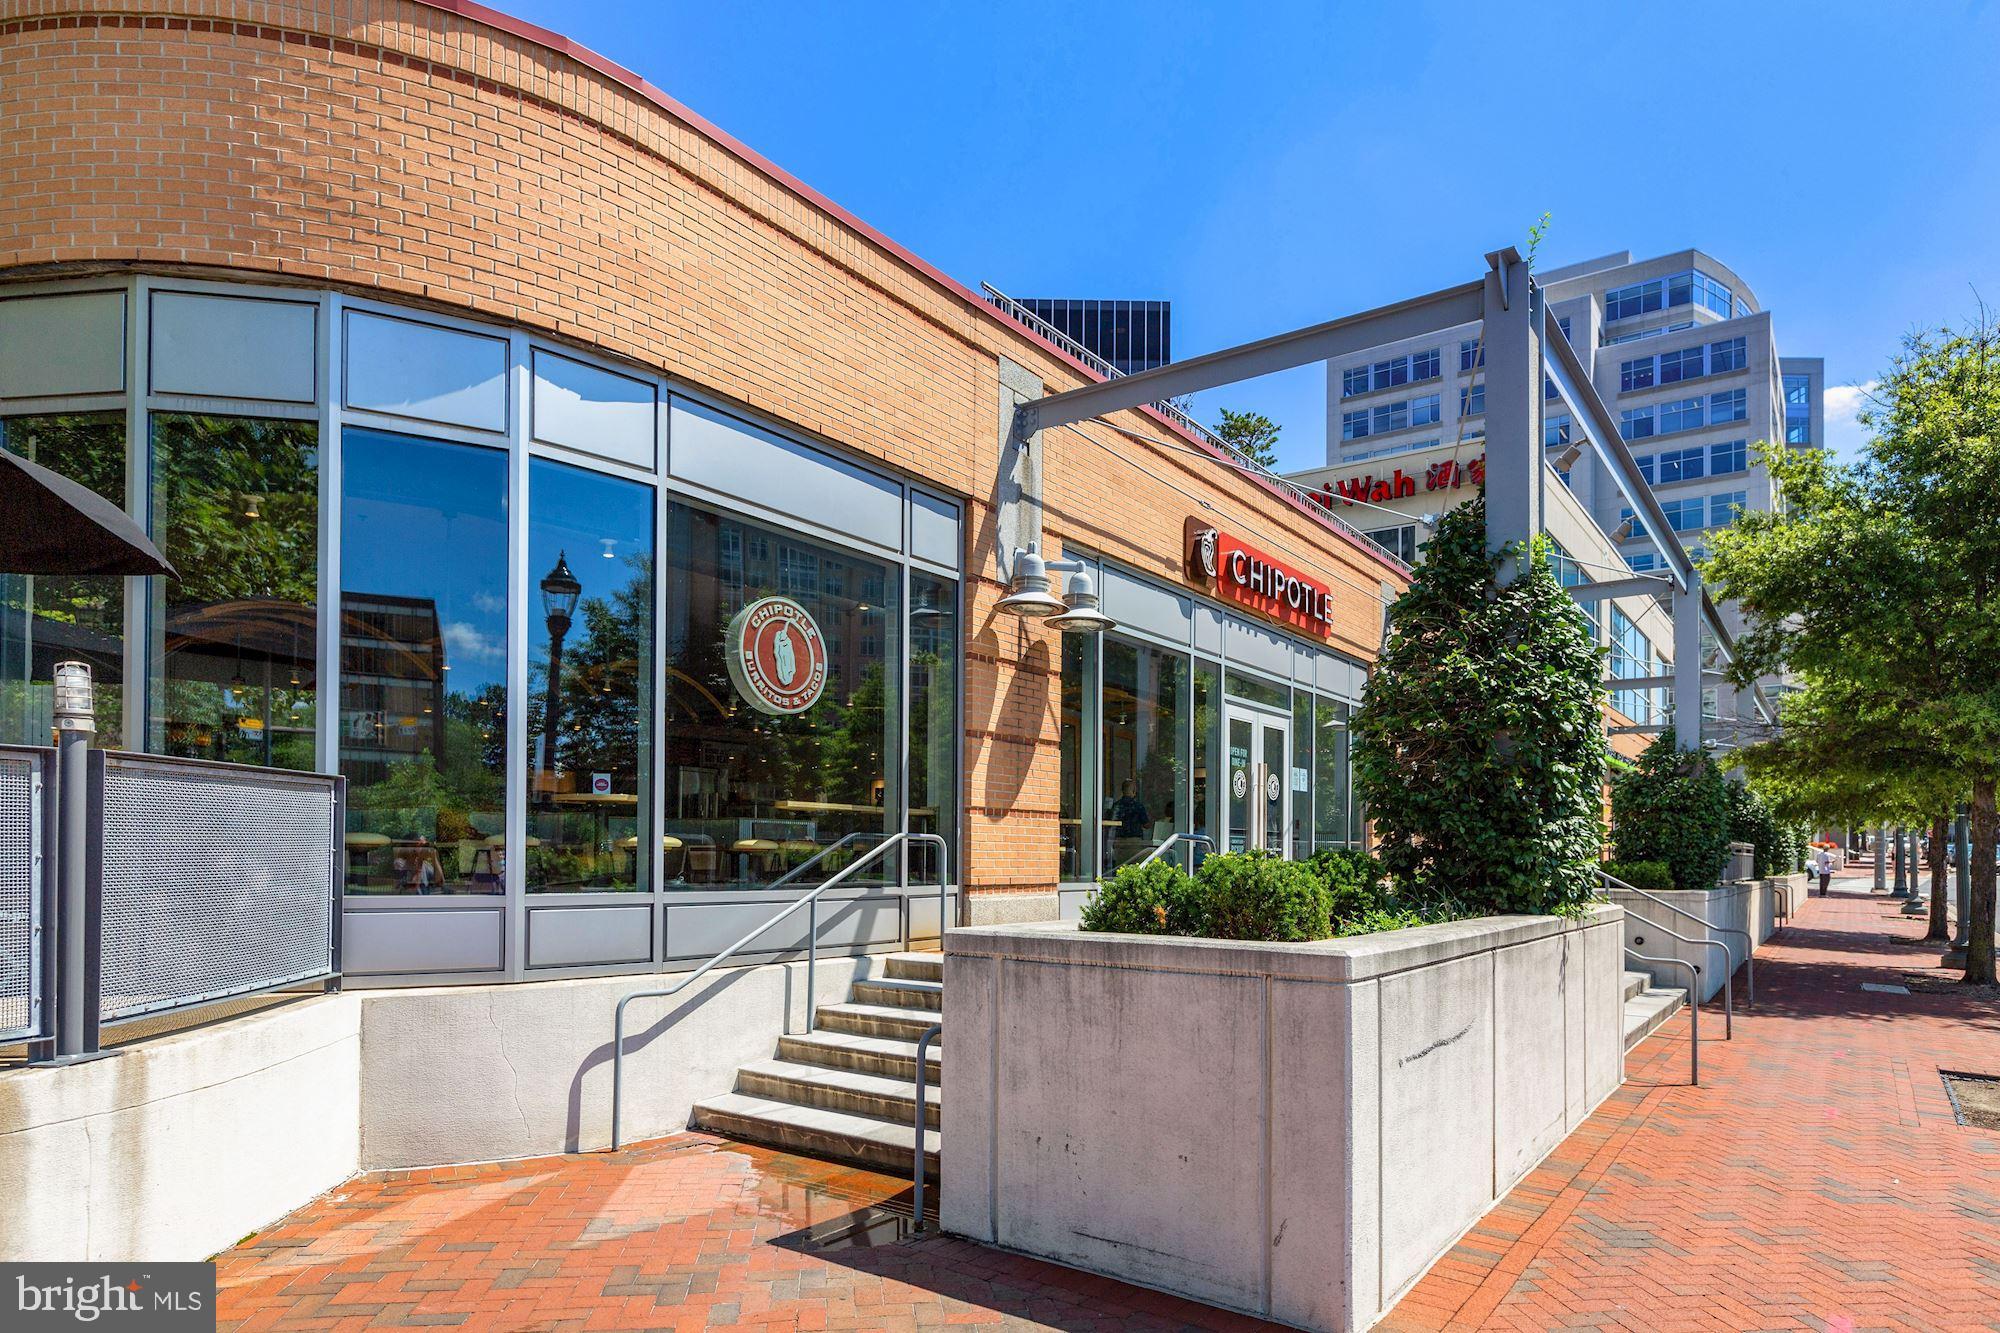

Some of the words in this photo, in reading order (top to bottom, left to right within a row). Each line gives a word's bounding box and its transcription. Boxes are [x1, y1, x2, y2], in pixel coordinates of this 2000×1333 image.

[1337, 469, 1415, 506] Wah
[1232, 549, 1334, 625] CHIPOTLE
[751, 604, 816, 639] CHIPOTLE
[744, 651, 790, 706] BURRITOS
[793, 697, 802, 705] &
[801, 663, 823, 700] TACOS
